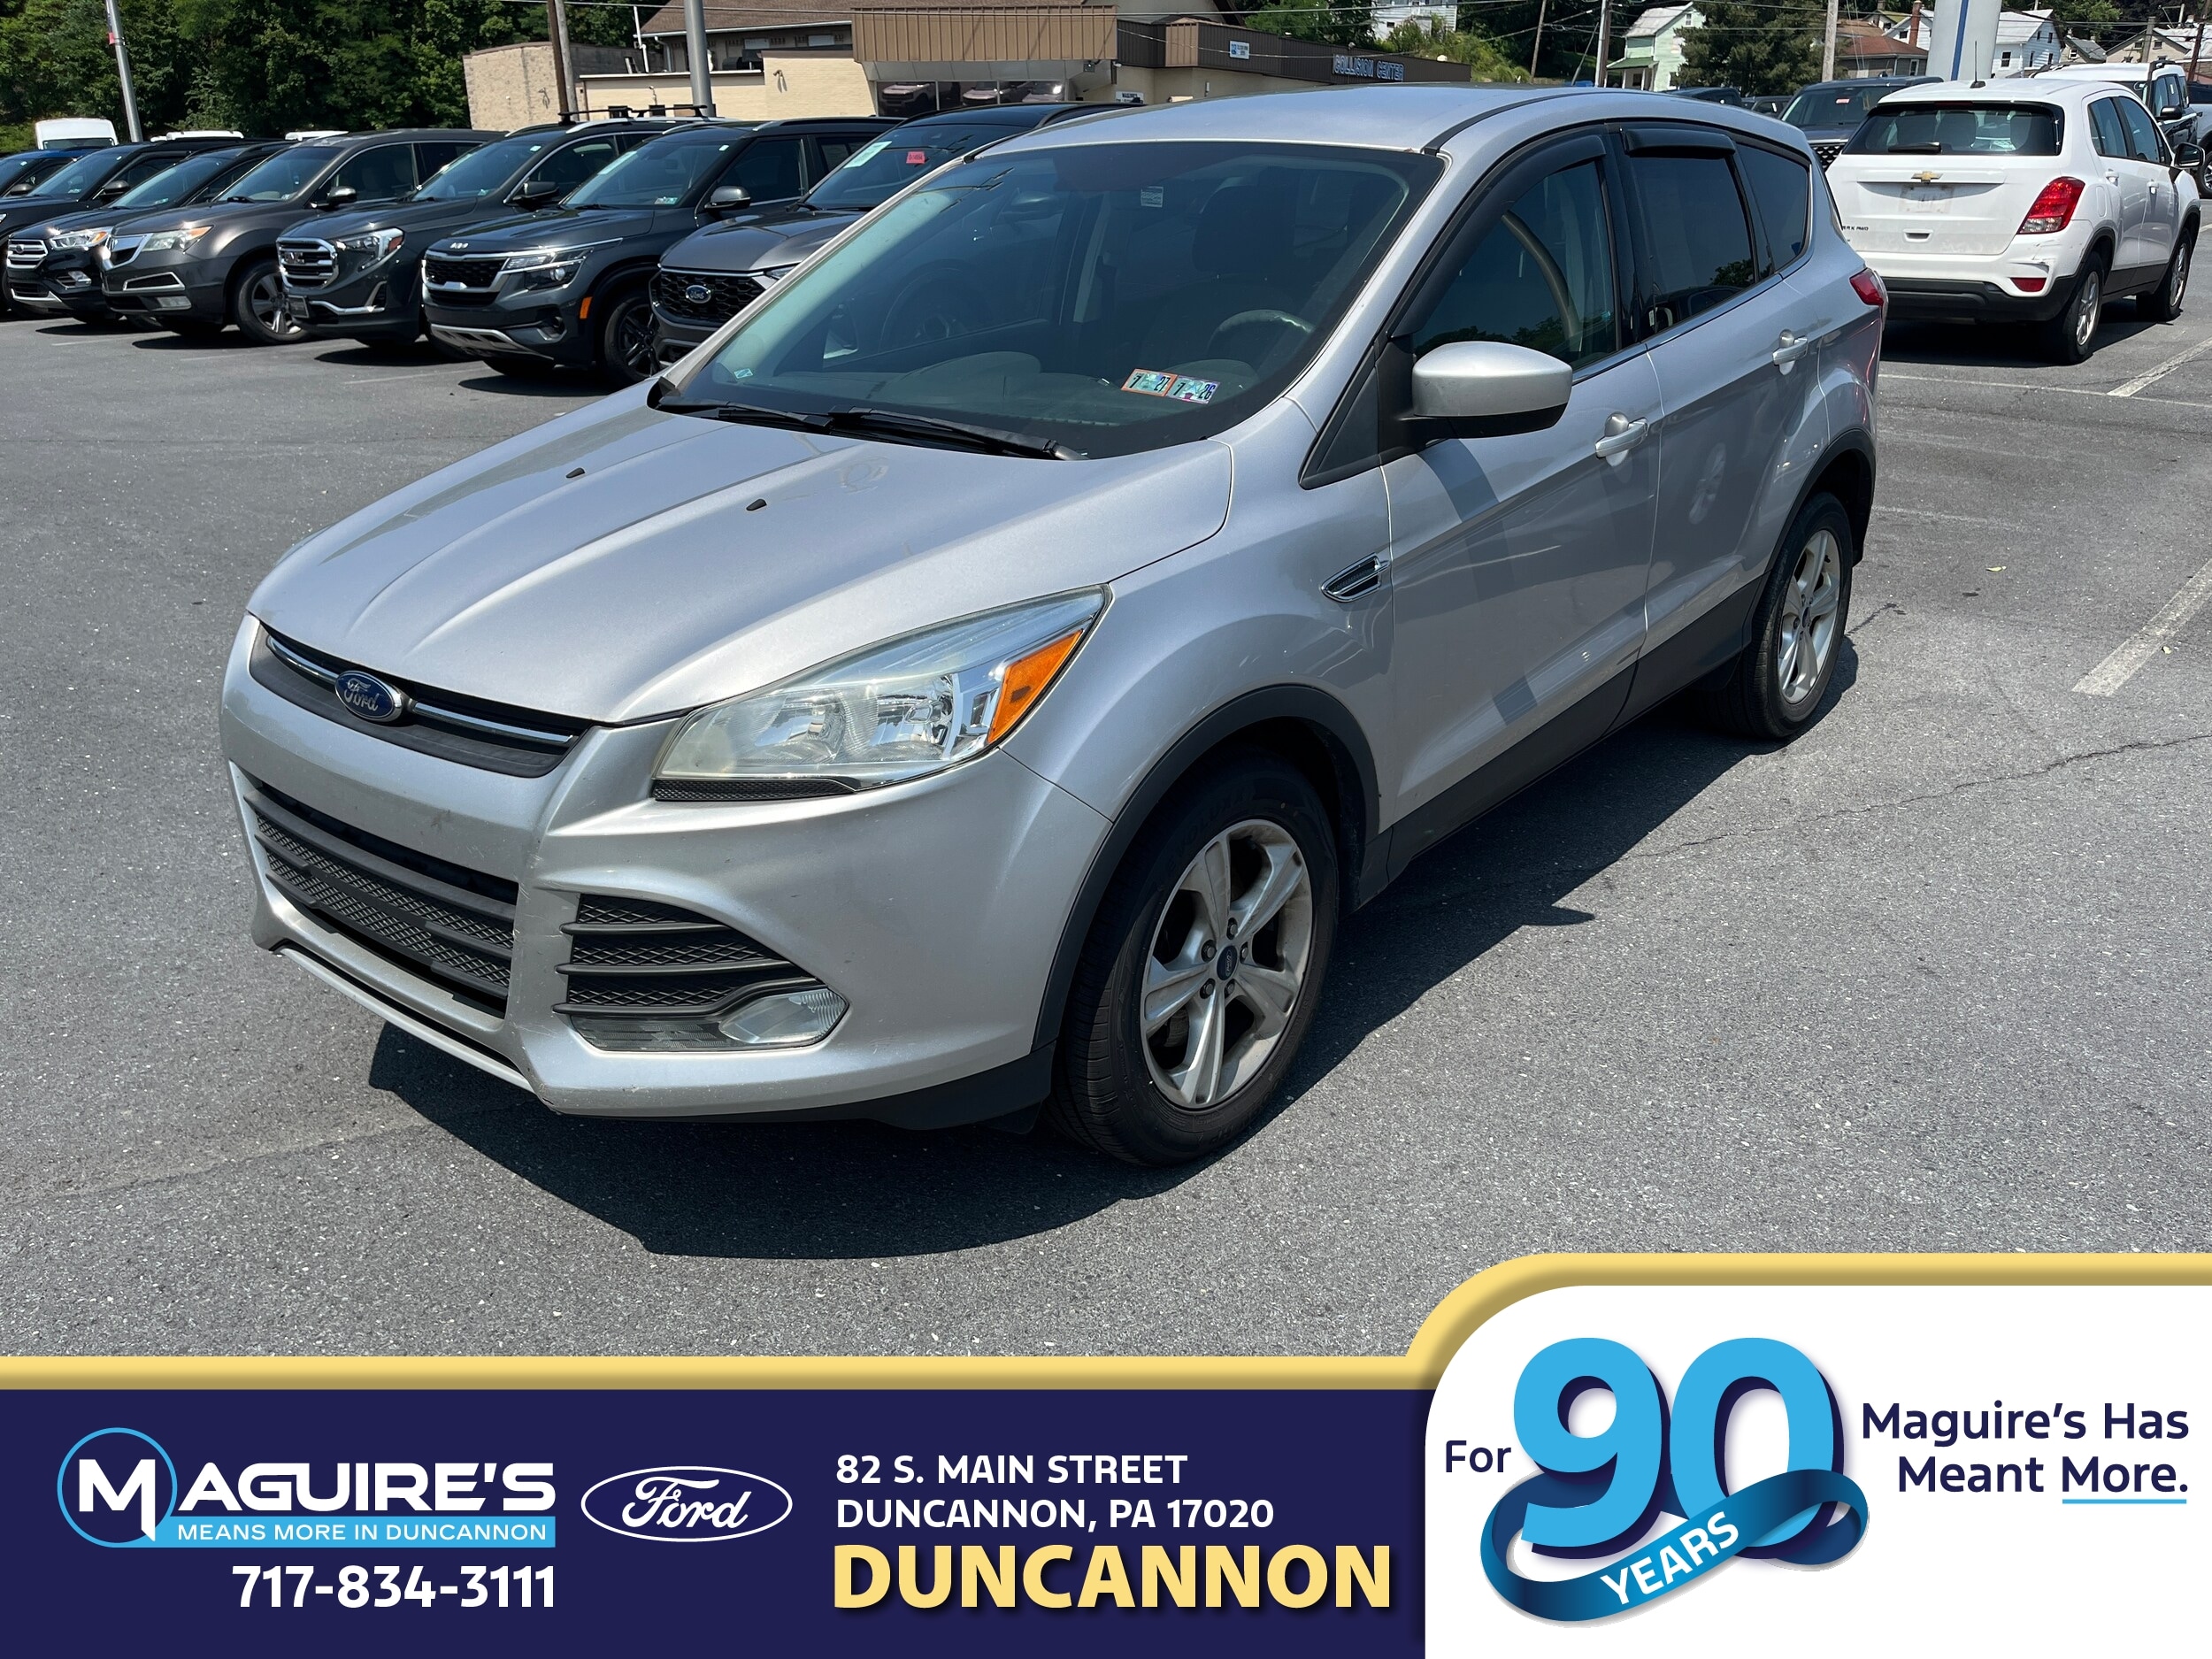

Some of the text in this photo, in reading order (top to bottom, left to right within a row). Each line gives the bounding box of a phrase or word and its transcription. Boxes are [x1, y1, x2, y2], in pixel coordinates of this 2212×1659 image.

[1333, 54, 1404, 81] COLLISION CENTER
[1129, 375, 1171, 393] 7 27
[1172, 381, 1217, 400] 7 26
[343, 677, 380, 711] Ford
